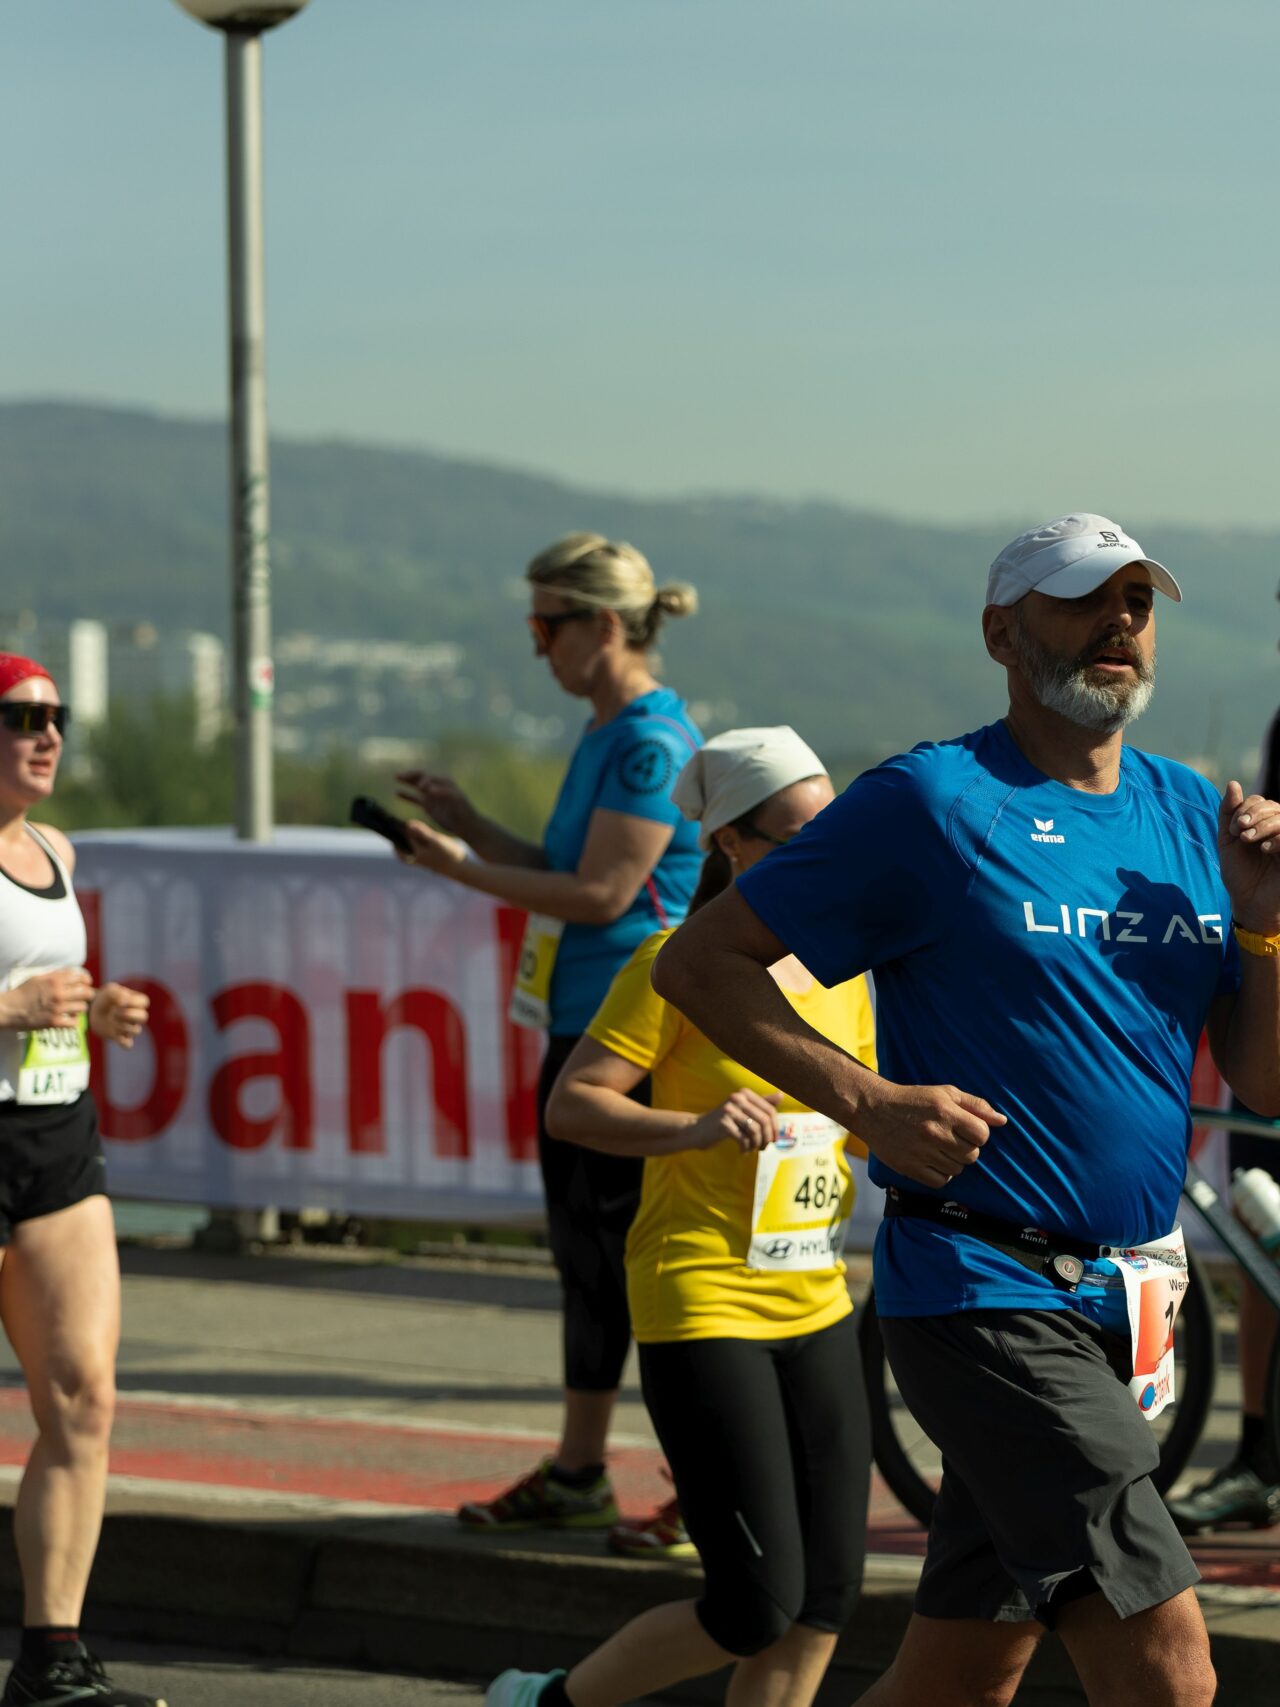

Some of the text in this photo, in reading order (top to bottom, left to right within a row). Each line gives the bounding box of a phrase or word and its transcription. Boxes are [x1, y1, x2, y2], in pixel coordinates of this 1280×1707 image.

[1030, 832, 1066, 844] erima
[1161, 913, 1224, 945] AG
[940, 1207, 969, 1220] skinfit
[1020, 1232, 1049, 1245] skinfit
